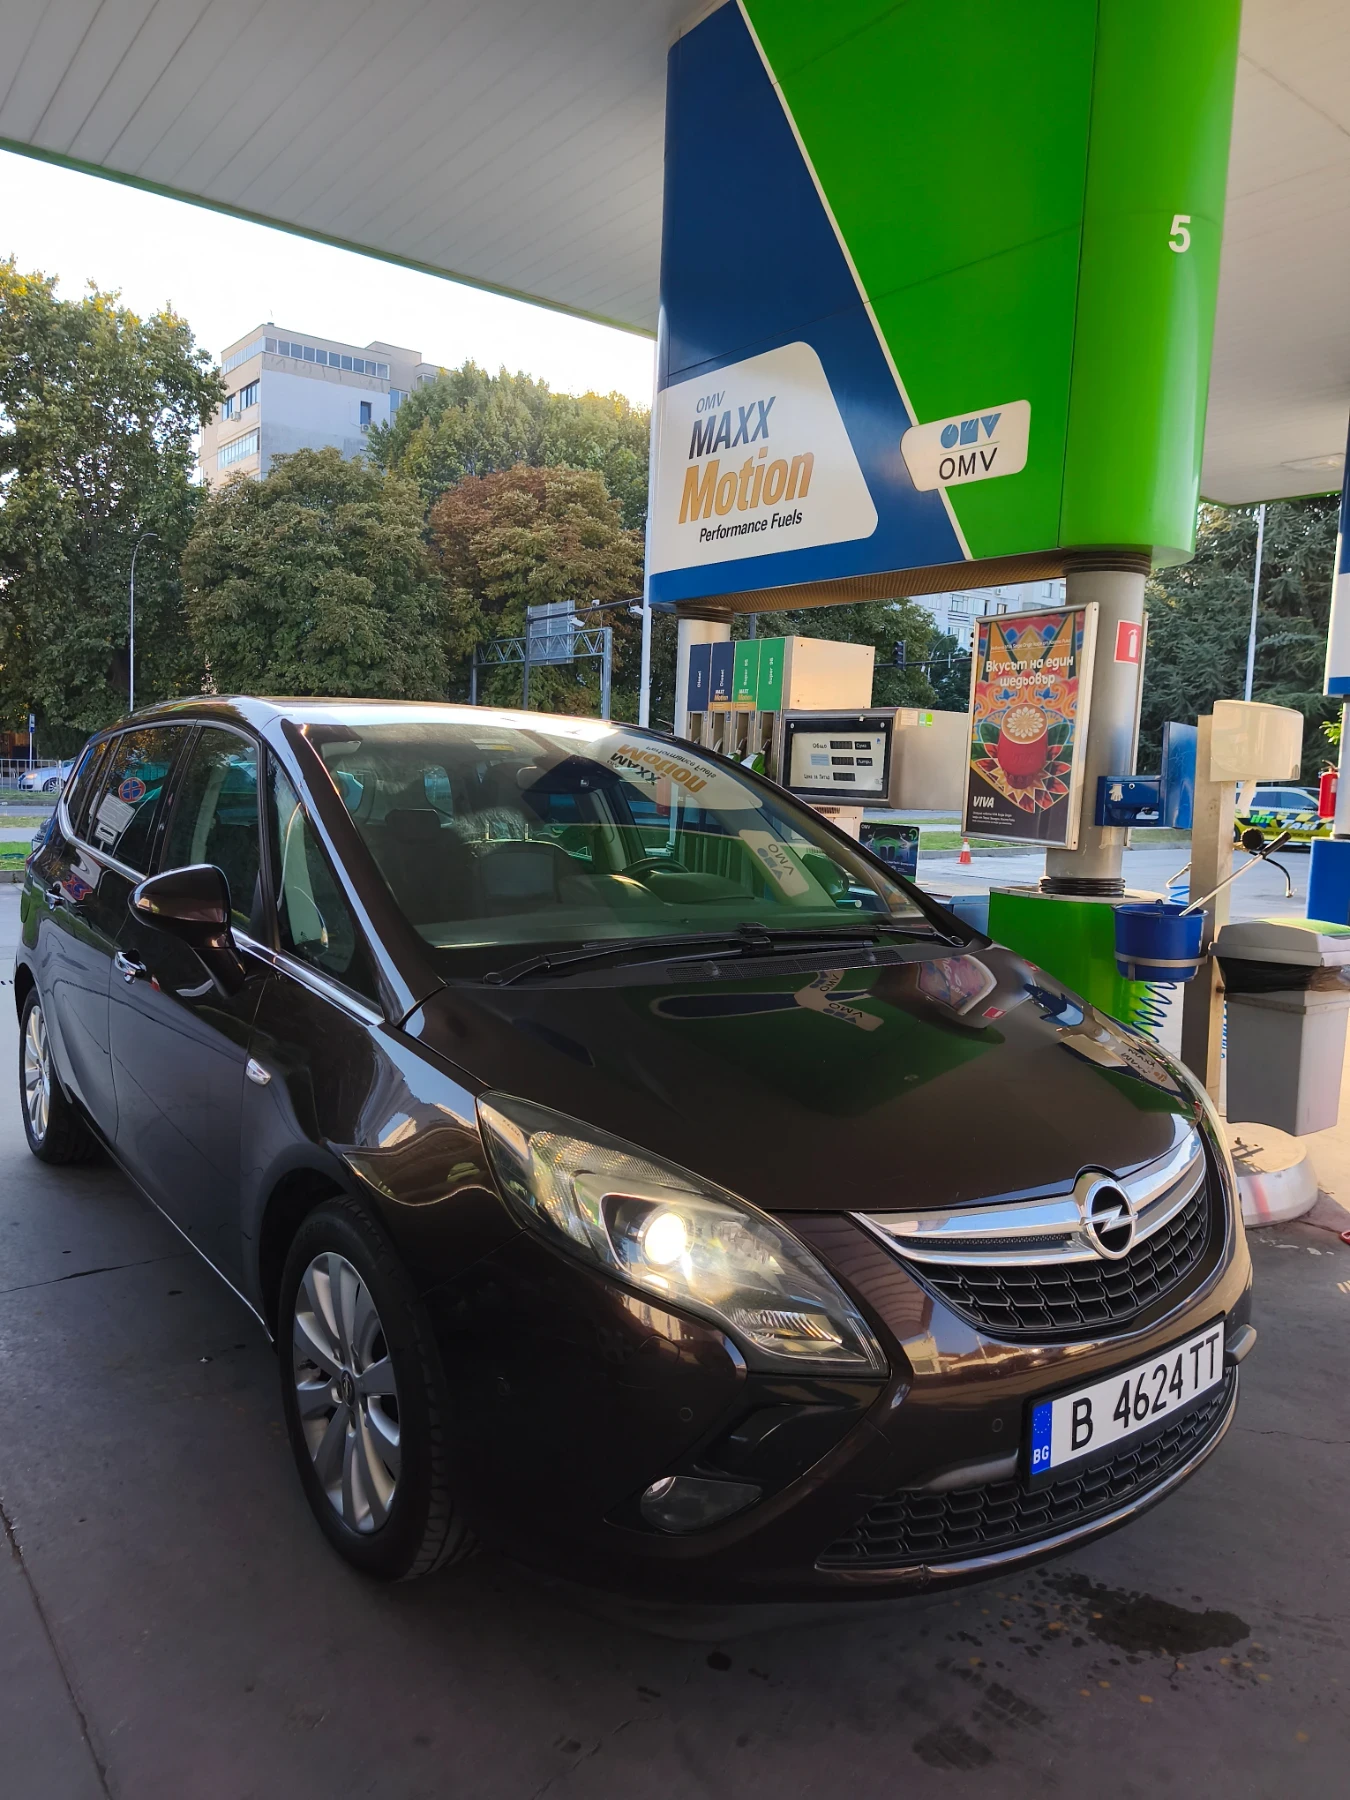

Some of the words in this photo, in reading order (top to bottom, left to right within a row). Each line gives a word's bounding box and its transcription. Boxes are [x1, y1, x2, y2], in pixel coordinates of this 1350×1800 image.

[1168, 214, 1191, 252] 5
[696, 391, 726, 413] OMV
[689, 396, 776, 459] MAXX
[939, 447, 998, 480] OMV
[678, 446, 815, 524] Motion
[699, 518, 768, 543] Performance
[771, 509, 803, 529] Fuels
[985, 660, 1028, 675] Вкусът
[1030, 658, 1044, 669] на
[1046, 656, 1074, 670] един
[1000, 672, 1056, 689] шедьовър
[973, 796, 995, 808] VIVA
[1071, 1397, 1093, 1451] B
[1113, 1353, 1184, 1429] 4624
[1190, 1332, 1220, 1390] TT
[1032, 1445, 1050, 1465] BG
